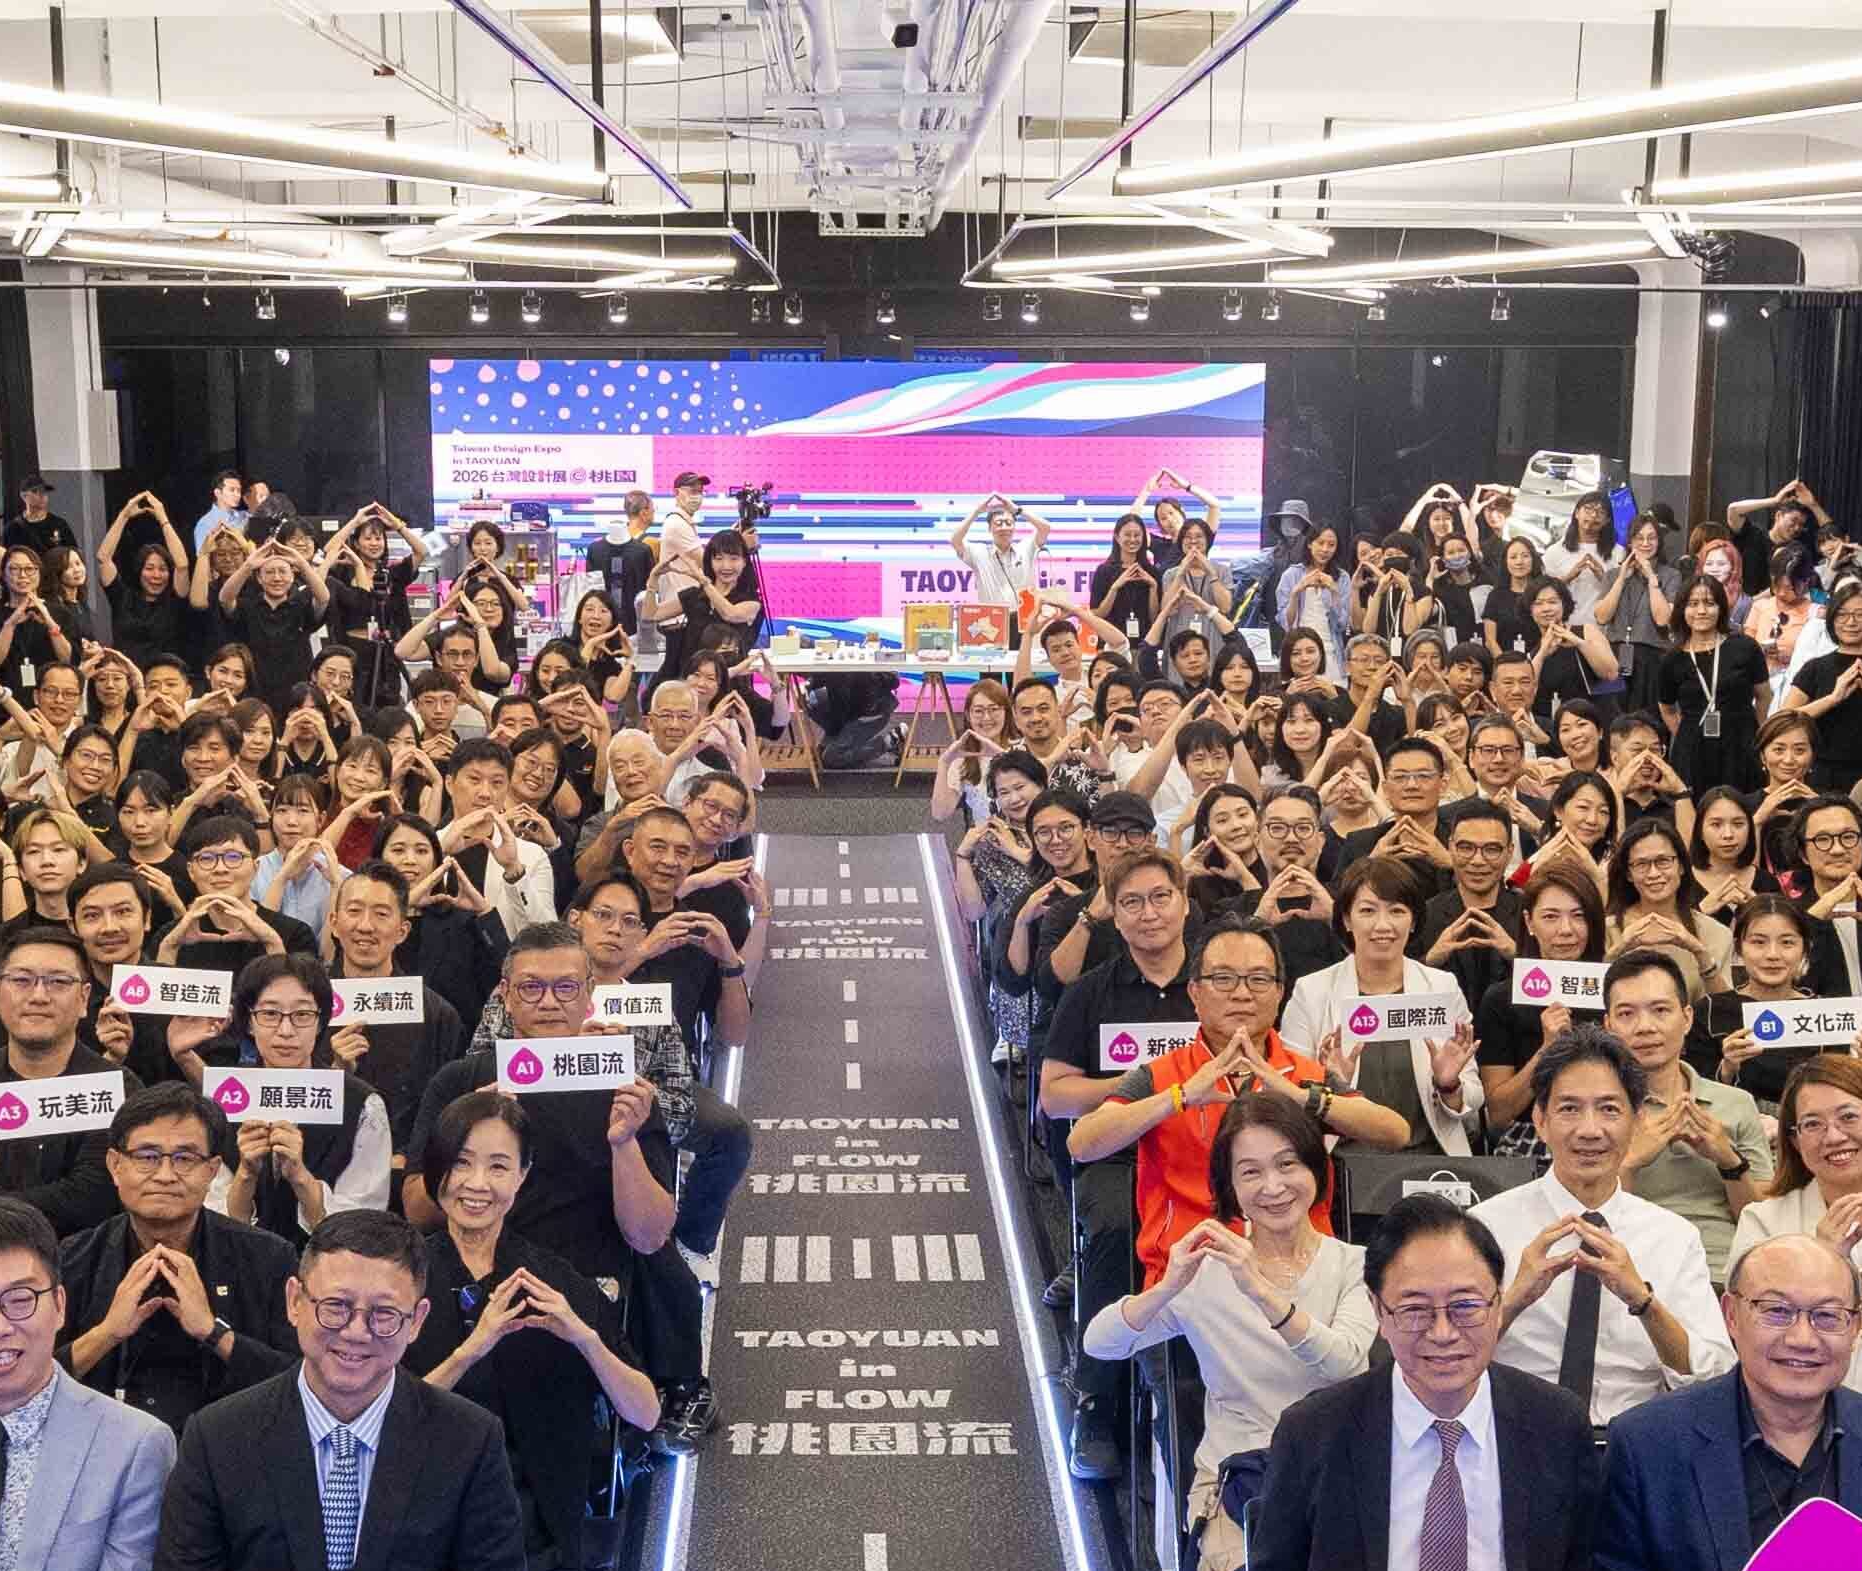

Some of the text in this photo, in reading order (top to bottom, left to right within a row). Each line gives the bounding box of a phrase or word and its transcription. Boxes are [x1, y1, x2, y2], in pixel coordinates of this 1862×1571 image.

[452, 444, 562, 454] Taiwan Design Expo
[452, 456, 521, 465] in TAOYUAN
[771, 917, 923, 928] TAOYUAN
[800, 937, 895, 945] FLOW
[1524, 978, 1549, 990] A14
[160, 982, 221, 1005] 智造流
[353, 991, 414, 1013] 永續流
[603, 997, 664, 1015] 價值流
[1352, 1006, 1448, 1029] A13 國際流
[1760, 1011, 1858, 1035] B1 文化流
[1111, 1043, 1136, 1055] A12
[515, 1051, 625, 1077] A1 桃園流
[38, 1090, 115, 1119] 玩美流
[221, 1086, 333, 1110] A2 願景流
[752, 1117, 960, 1130] TAOYUAN
[835, 1136, 880, 1148] in
[792, 1154, 922, 1167] FLOW
[748, 1173, 971, 1194] 桃園流
[734, 1329, 1000, 1347] TAOYUAN
[839, 1358, 897, 1377] in
[785, 1389, 953, 1409] FLOW
[728, 1421, 1018, 1455] 桃園流
